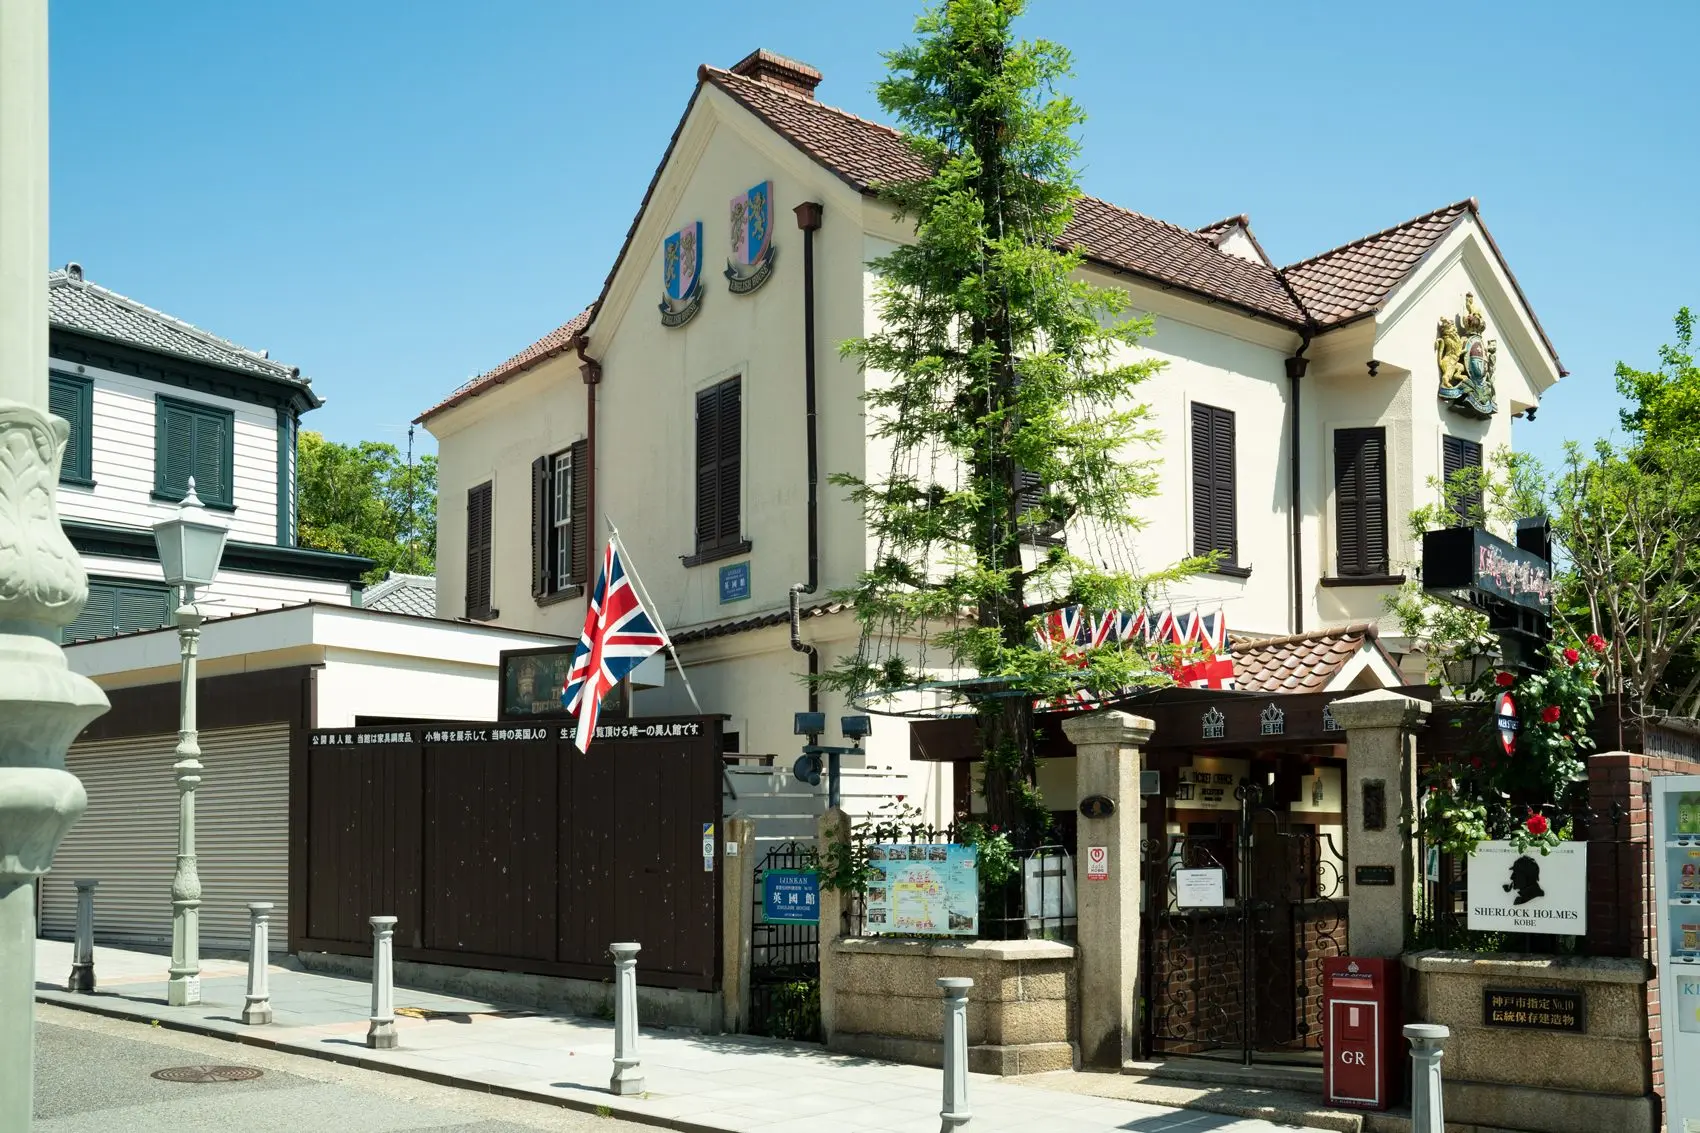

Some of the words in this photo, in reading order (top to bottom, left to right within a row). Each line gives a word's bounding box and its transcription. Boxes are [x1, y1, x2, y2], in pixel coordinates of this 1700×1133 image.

[1192, 772, 1212, 784] TICKET
[1474, 907, 1530, 918] SHERLOCK
[1533, 909, 1578, 920] HOLMES
[1514, 919, 1536, 927] KOBE
[1492, 995, 1550, 1010] 神戸市指定
[1341, 1051, 1366, 1066] GR
